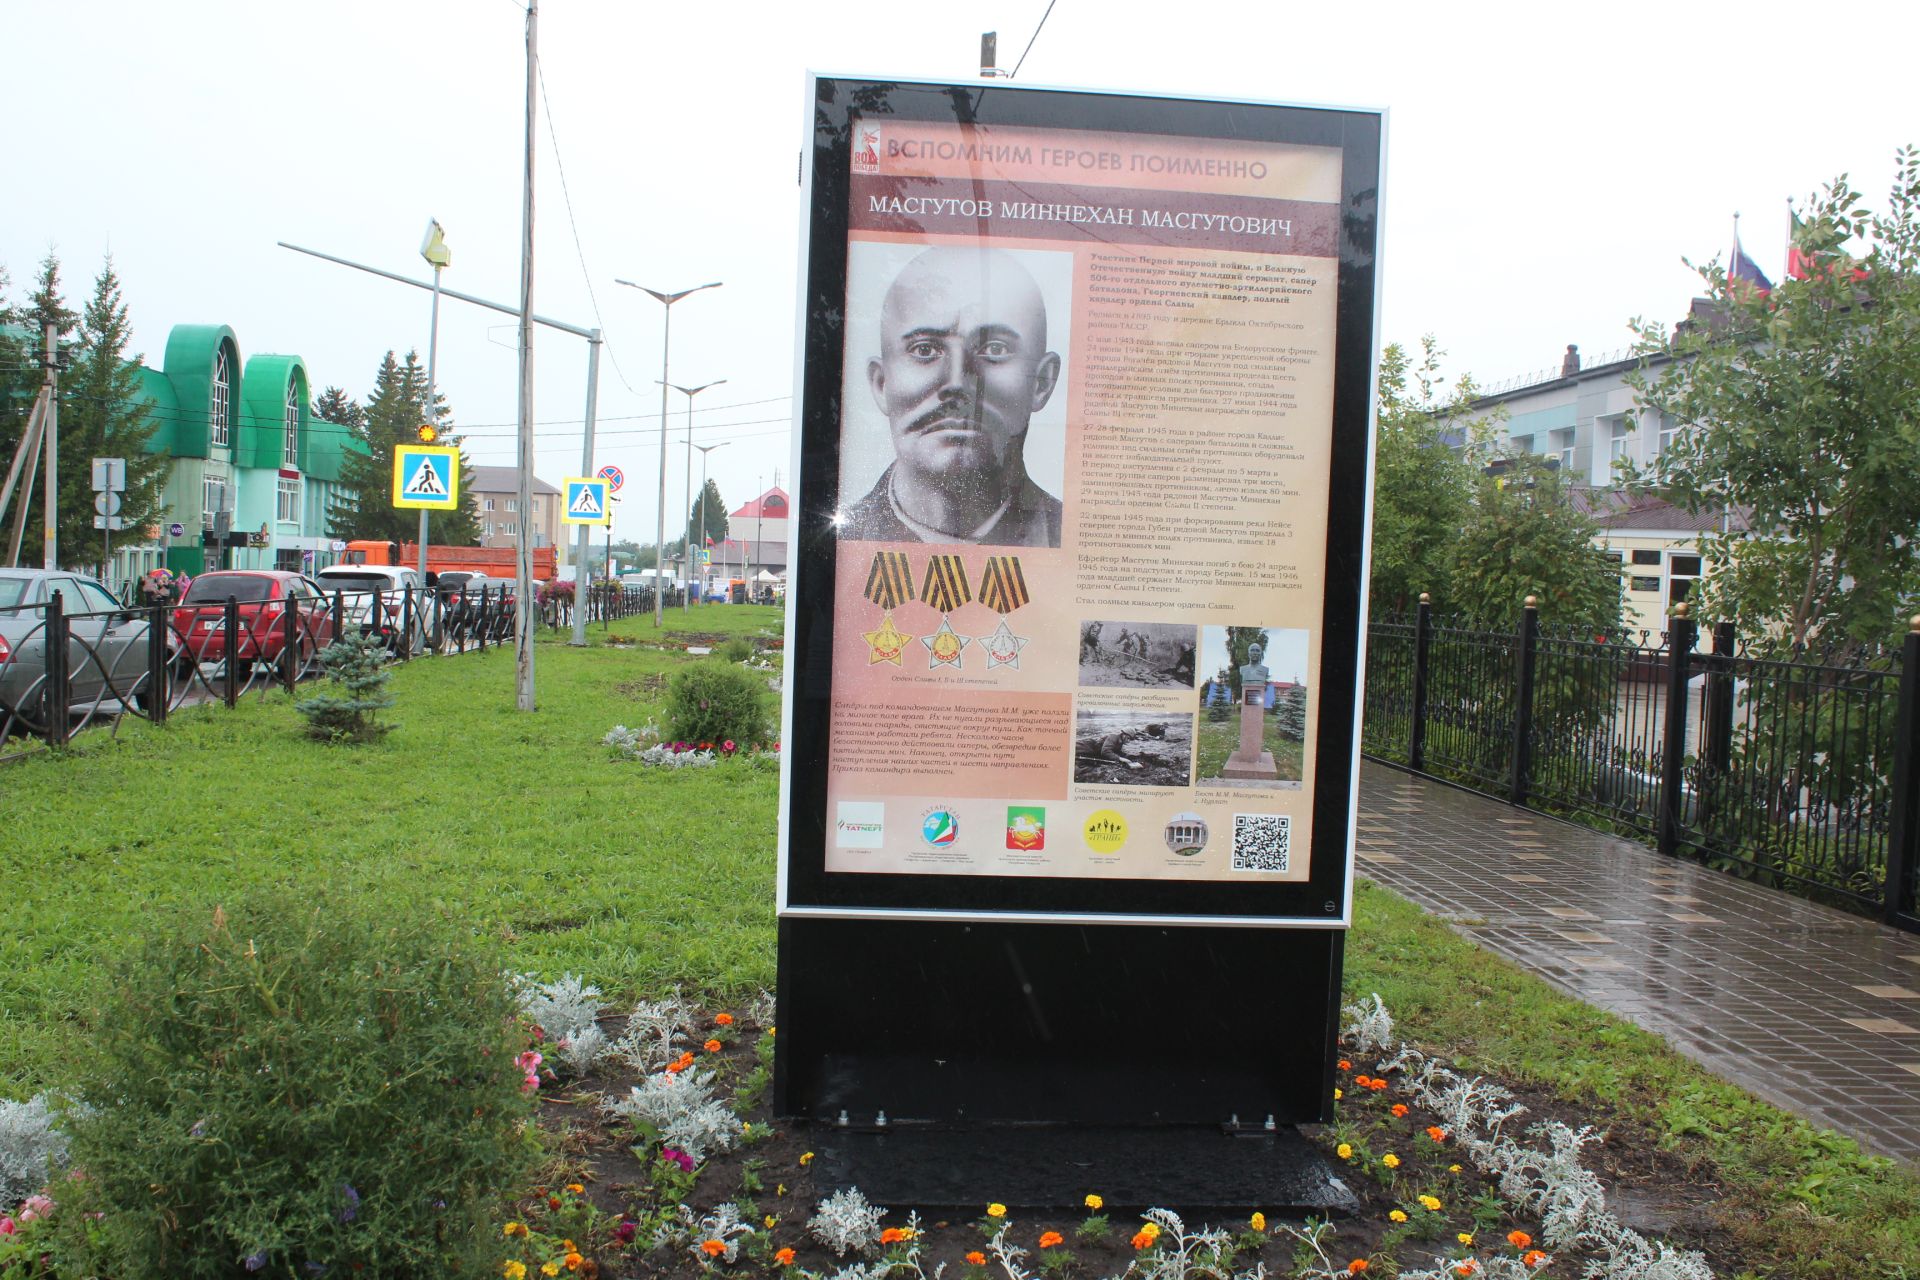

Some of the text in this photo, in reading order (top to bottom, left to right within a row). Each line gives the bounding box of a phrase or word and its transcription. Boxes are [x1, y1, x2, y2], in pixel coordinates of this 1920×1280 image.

[886, 138, 1269, 180] ВСПОМНИМ ГЕРОЕВ ПОИМЕННО
[868, 194, 1293, 237] МАСГУТОВ МИННЕХАН МАСГУТОВИЧ
[1264, 264, 1306, 275] Великую
[1200, 270, 1243, 282] младший
[1245, 275, 1288, 285] сержант,
[1143, 288, 1209, 301] Георгиевский
[1211, 294, 1251, 303] кавалер,
[1253, 294, 1290, 304] полный
[1164, 299, 1195, 308] Славы
